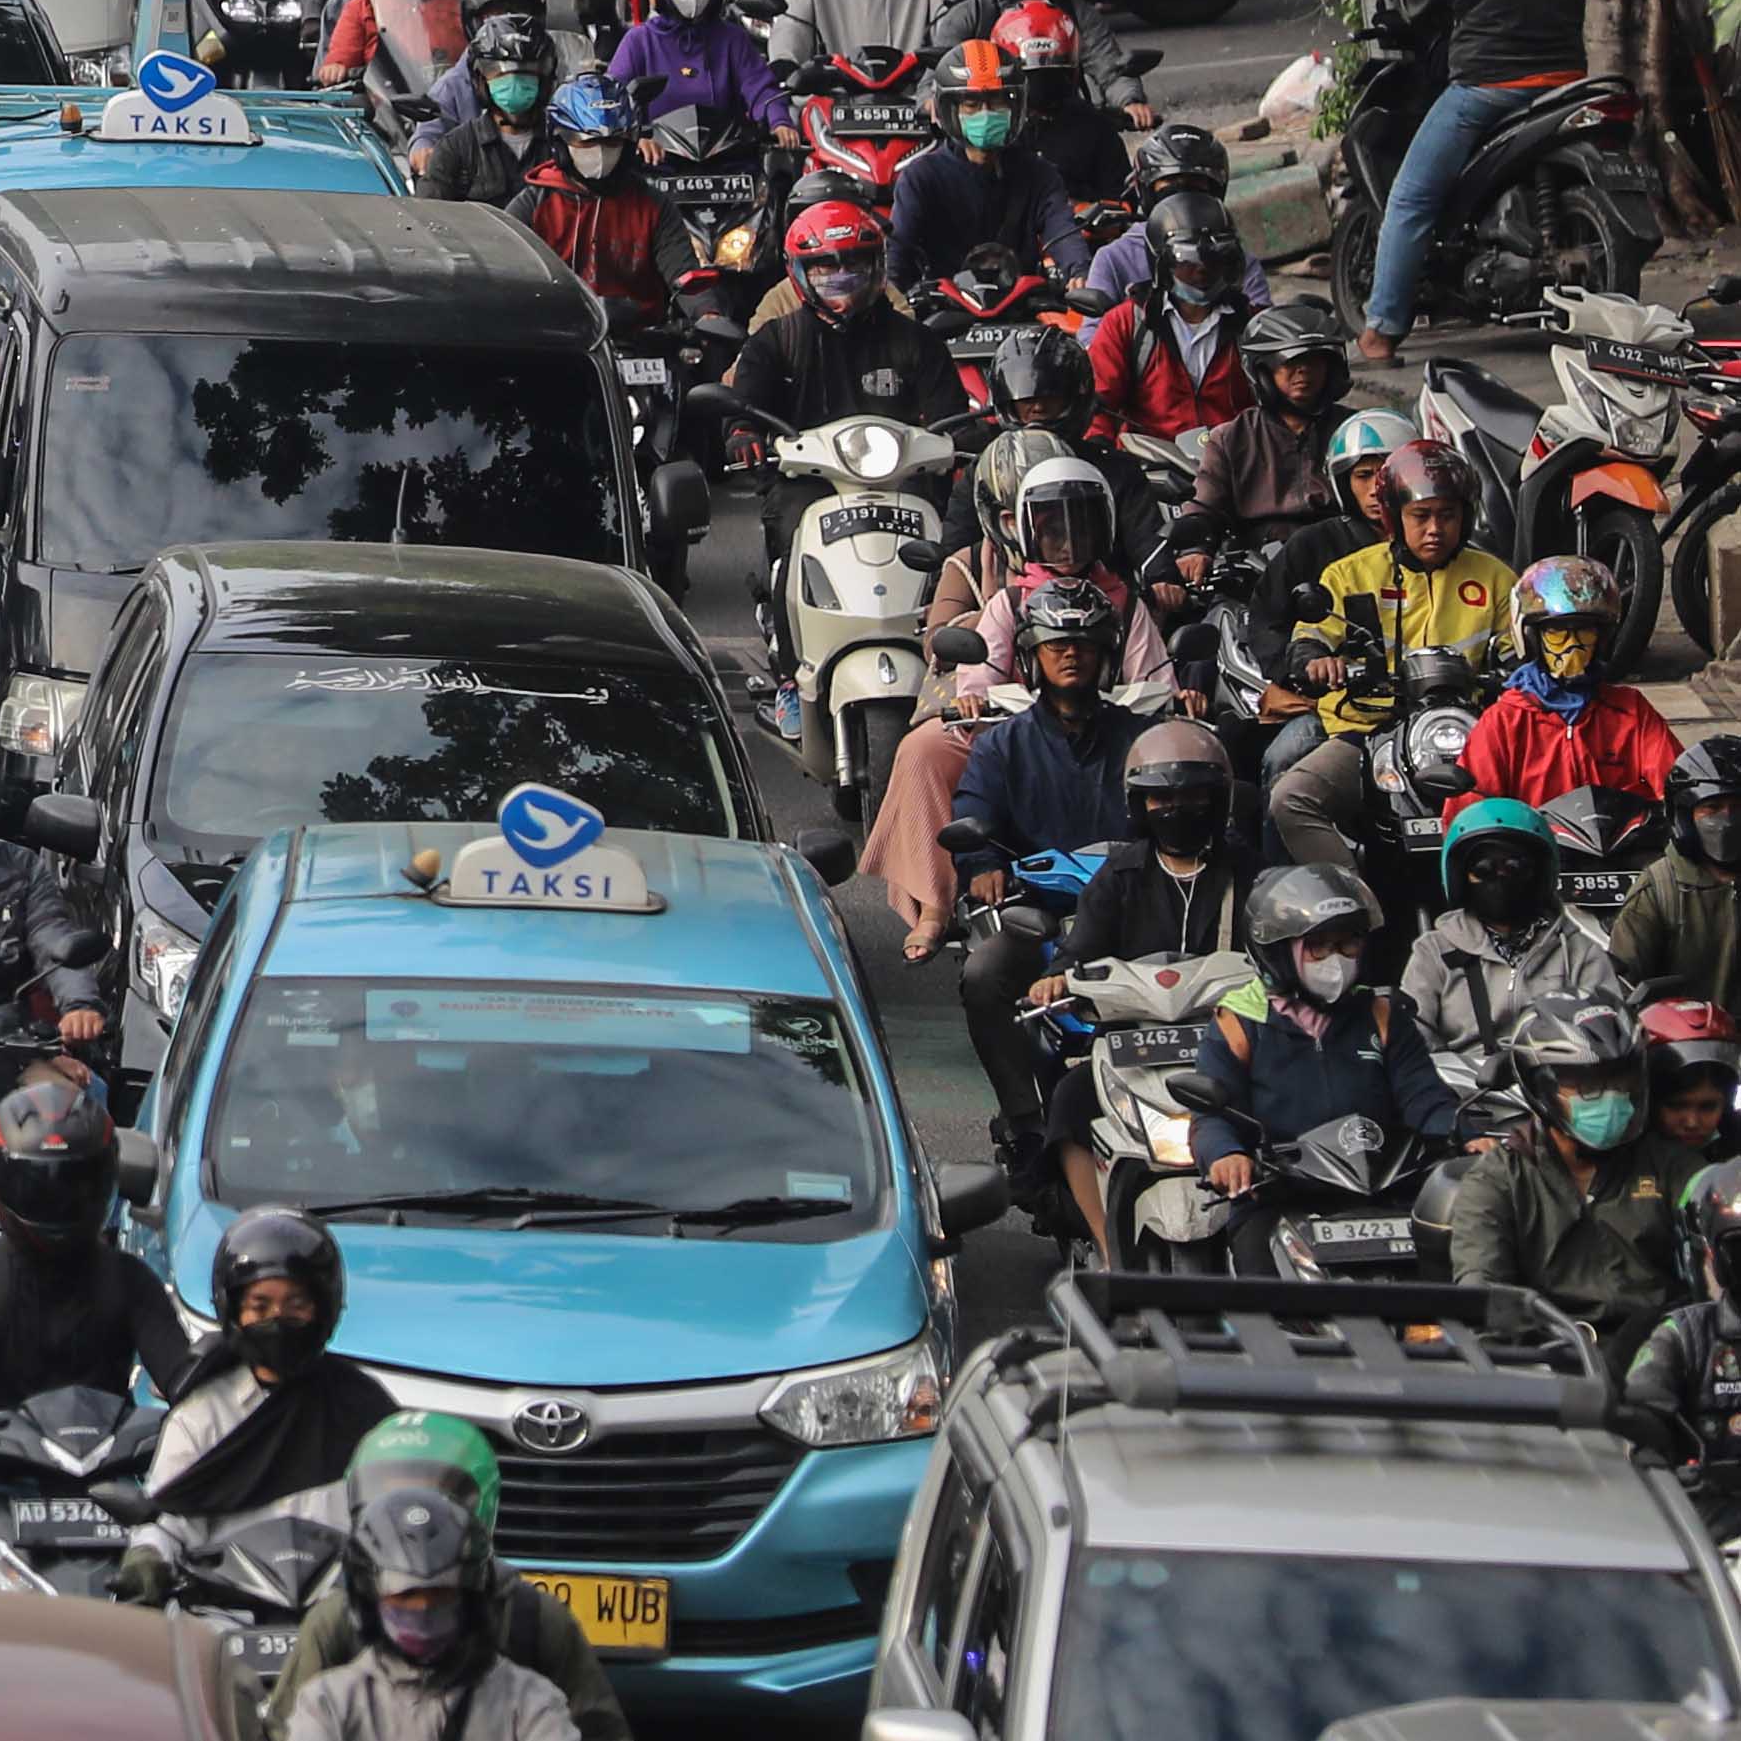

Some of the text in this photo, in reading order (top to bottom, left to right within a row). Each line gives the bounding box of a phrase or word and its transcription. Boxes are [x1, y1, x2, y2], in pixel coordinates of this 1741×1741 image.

[130, 115, 226, 135] TAKSI
[965, 329, 1003, 343] 4303
[1609, 343, 1643, 362] 4322
[822, 508, 920, 529] B 3197 TFF
[482, 871, 609, 899] TAKSI
[1574, 876, 1620, 891] 3855
[1110, 1034, 1123, 1050] B
[1132, 1030, 1180, 1047] 3462
[1321, 1221, 1396, 1241] B 3423
[20, 1502, 47, 1522] AD
[597, 1583, 660, 1625] WUB
